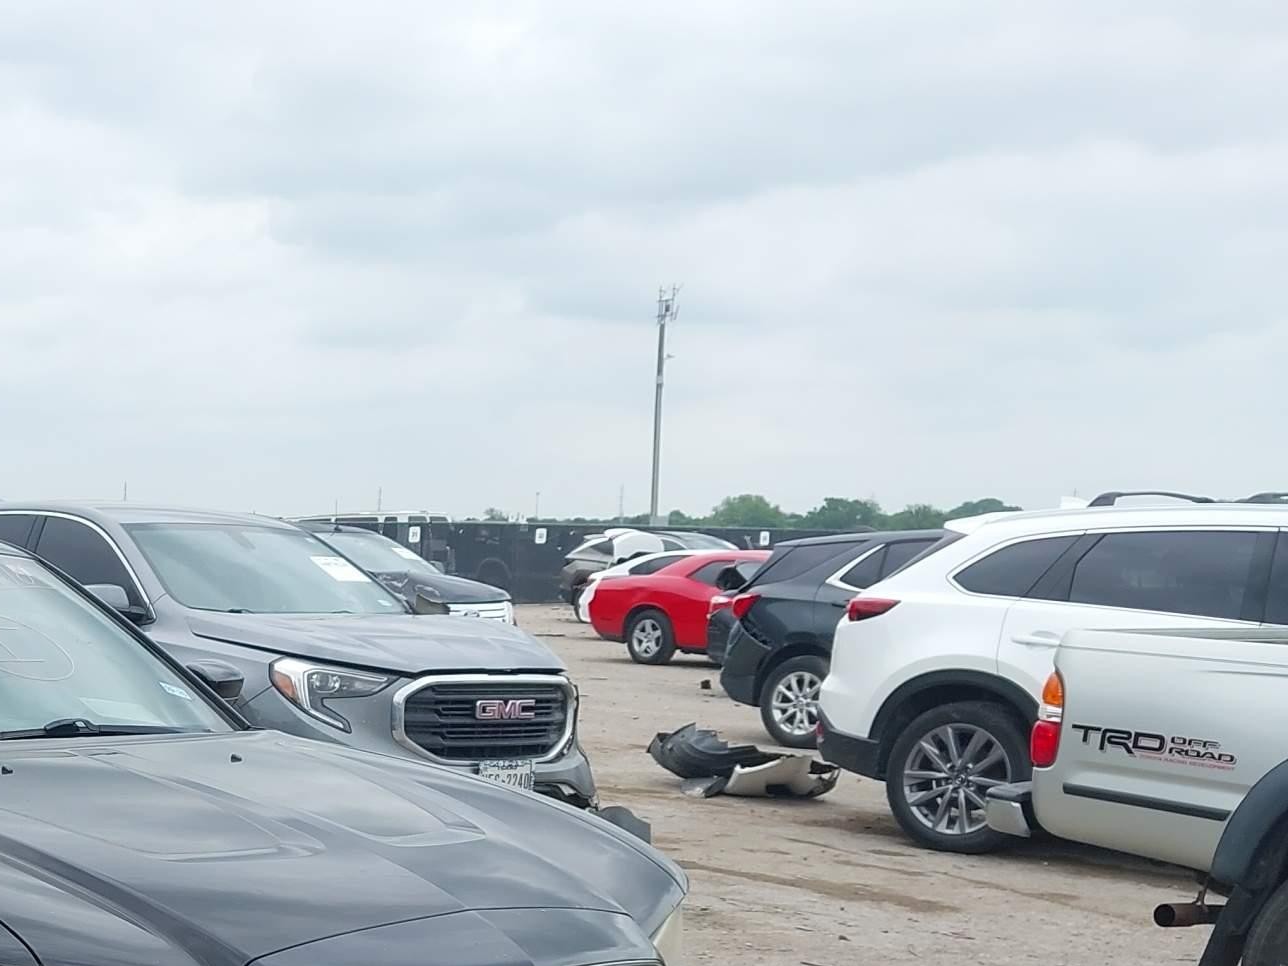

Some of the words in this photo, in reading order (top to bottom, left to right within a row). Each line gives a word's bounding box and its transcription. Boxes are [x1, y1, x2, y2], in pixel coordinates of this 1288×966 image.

[475, 699, 536, 720] GMC
[1072, 724, 1166, 757] TRD
[1171, 736, 1221, 749] OFF
[1168, 747, 1237, 764] ROAD
